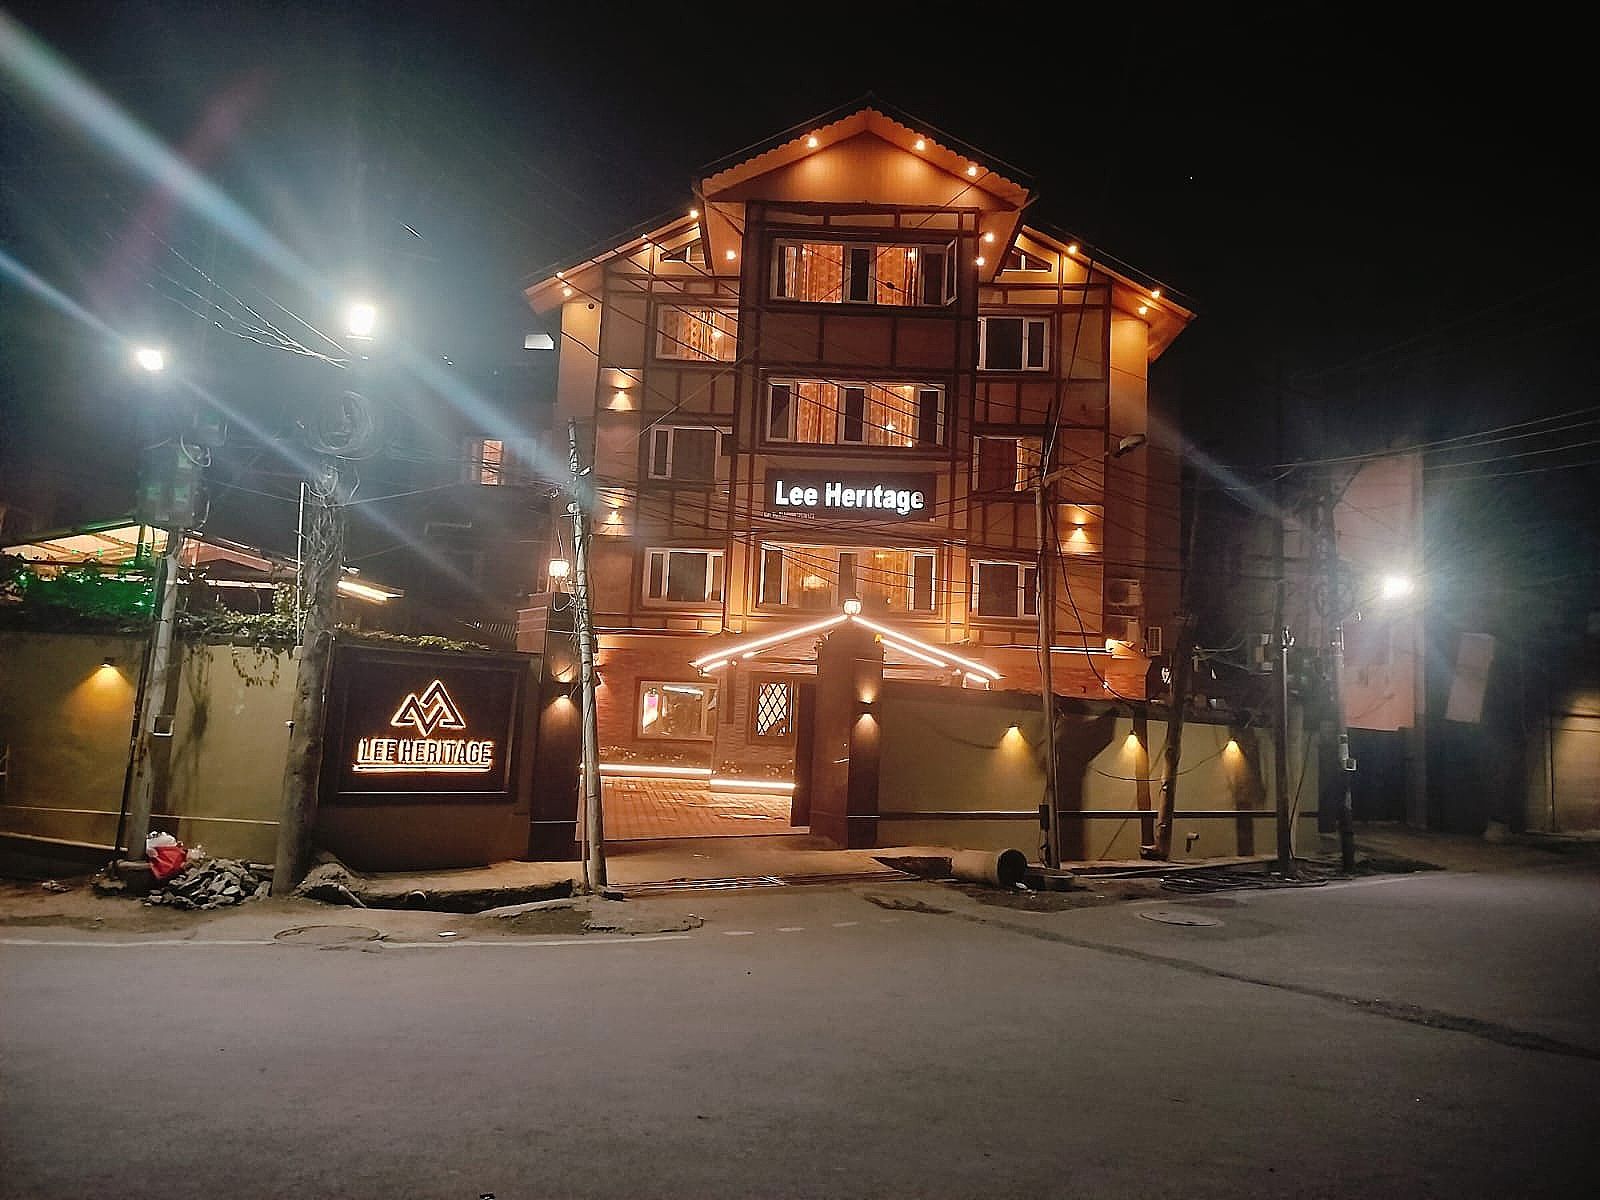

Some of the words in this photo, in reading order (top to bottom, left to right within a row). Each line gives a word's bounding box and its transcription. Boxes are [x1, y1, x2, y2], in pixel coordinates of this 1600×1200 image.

[775, 480, 818, 506] Lee
[825, 481, 925, 515] Heritage
[358, 738, 397, 763] LEE
[400, 738, 493, 764] HERITAGE
